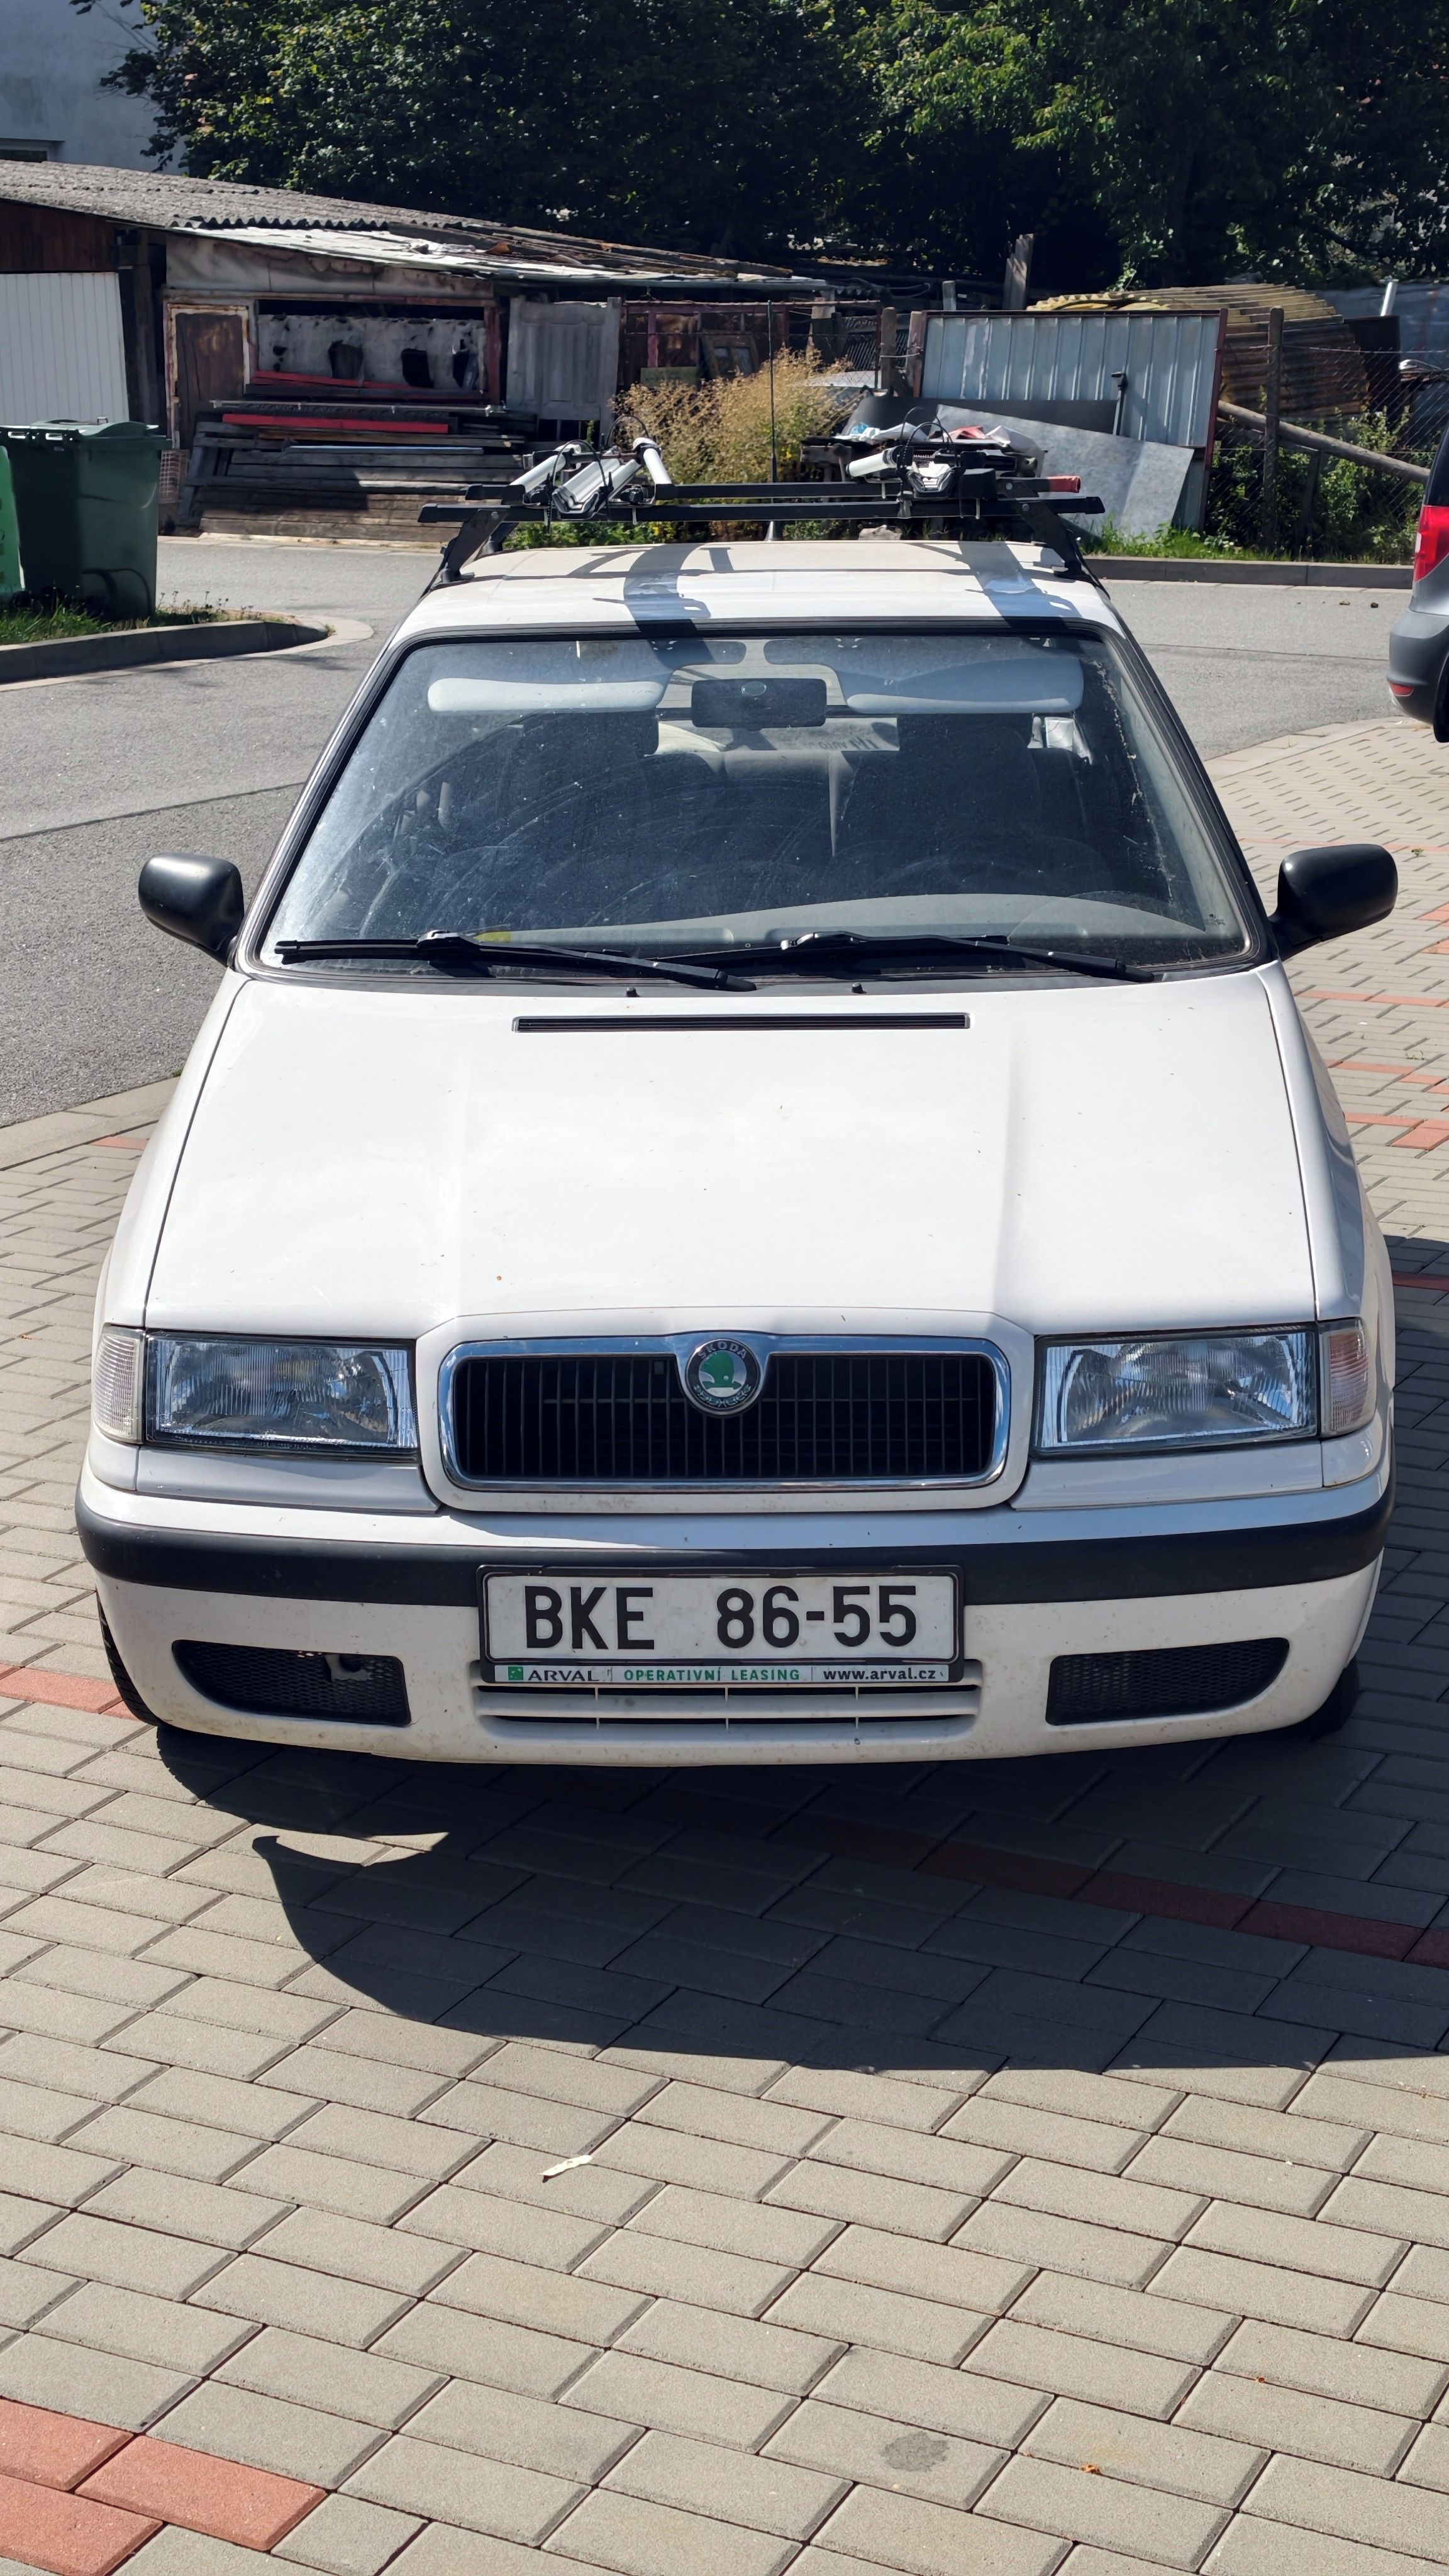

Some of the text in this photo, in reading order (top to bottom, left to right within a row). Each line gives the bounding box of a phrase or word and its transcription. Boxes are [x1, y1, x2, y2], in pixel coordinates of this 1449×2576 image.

[525, 1585, 917, 1650] BKE 86-55
[528, 1667, 936, 1681] ARVAL OPERATIVNÍ LEASING www.arval.cz
